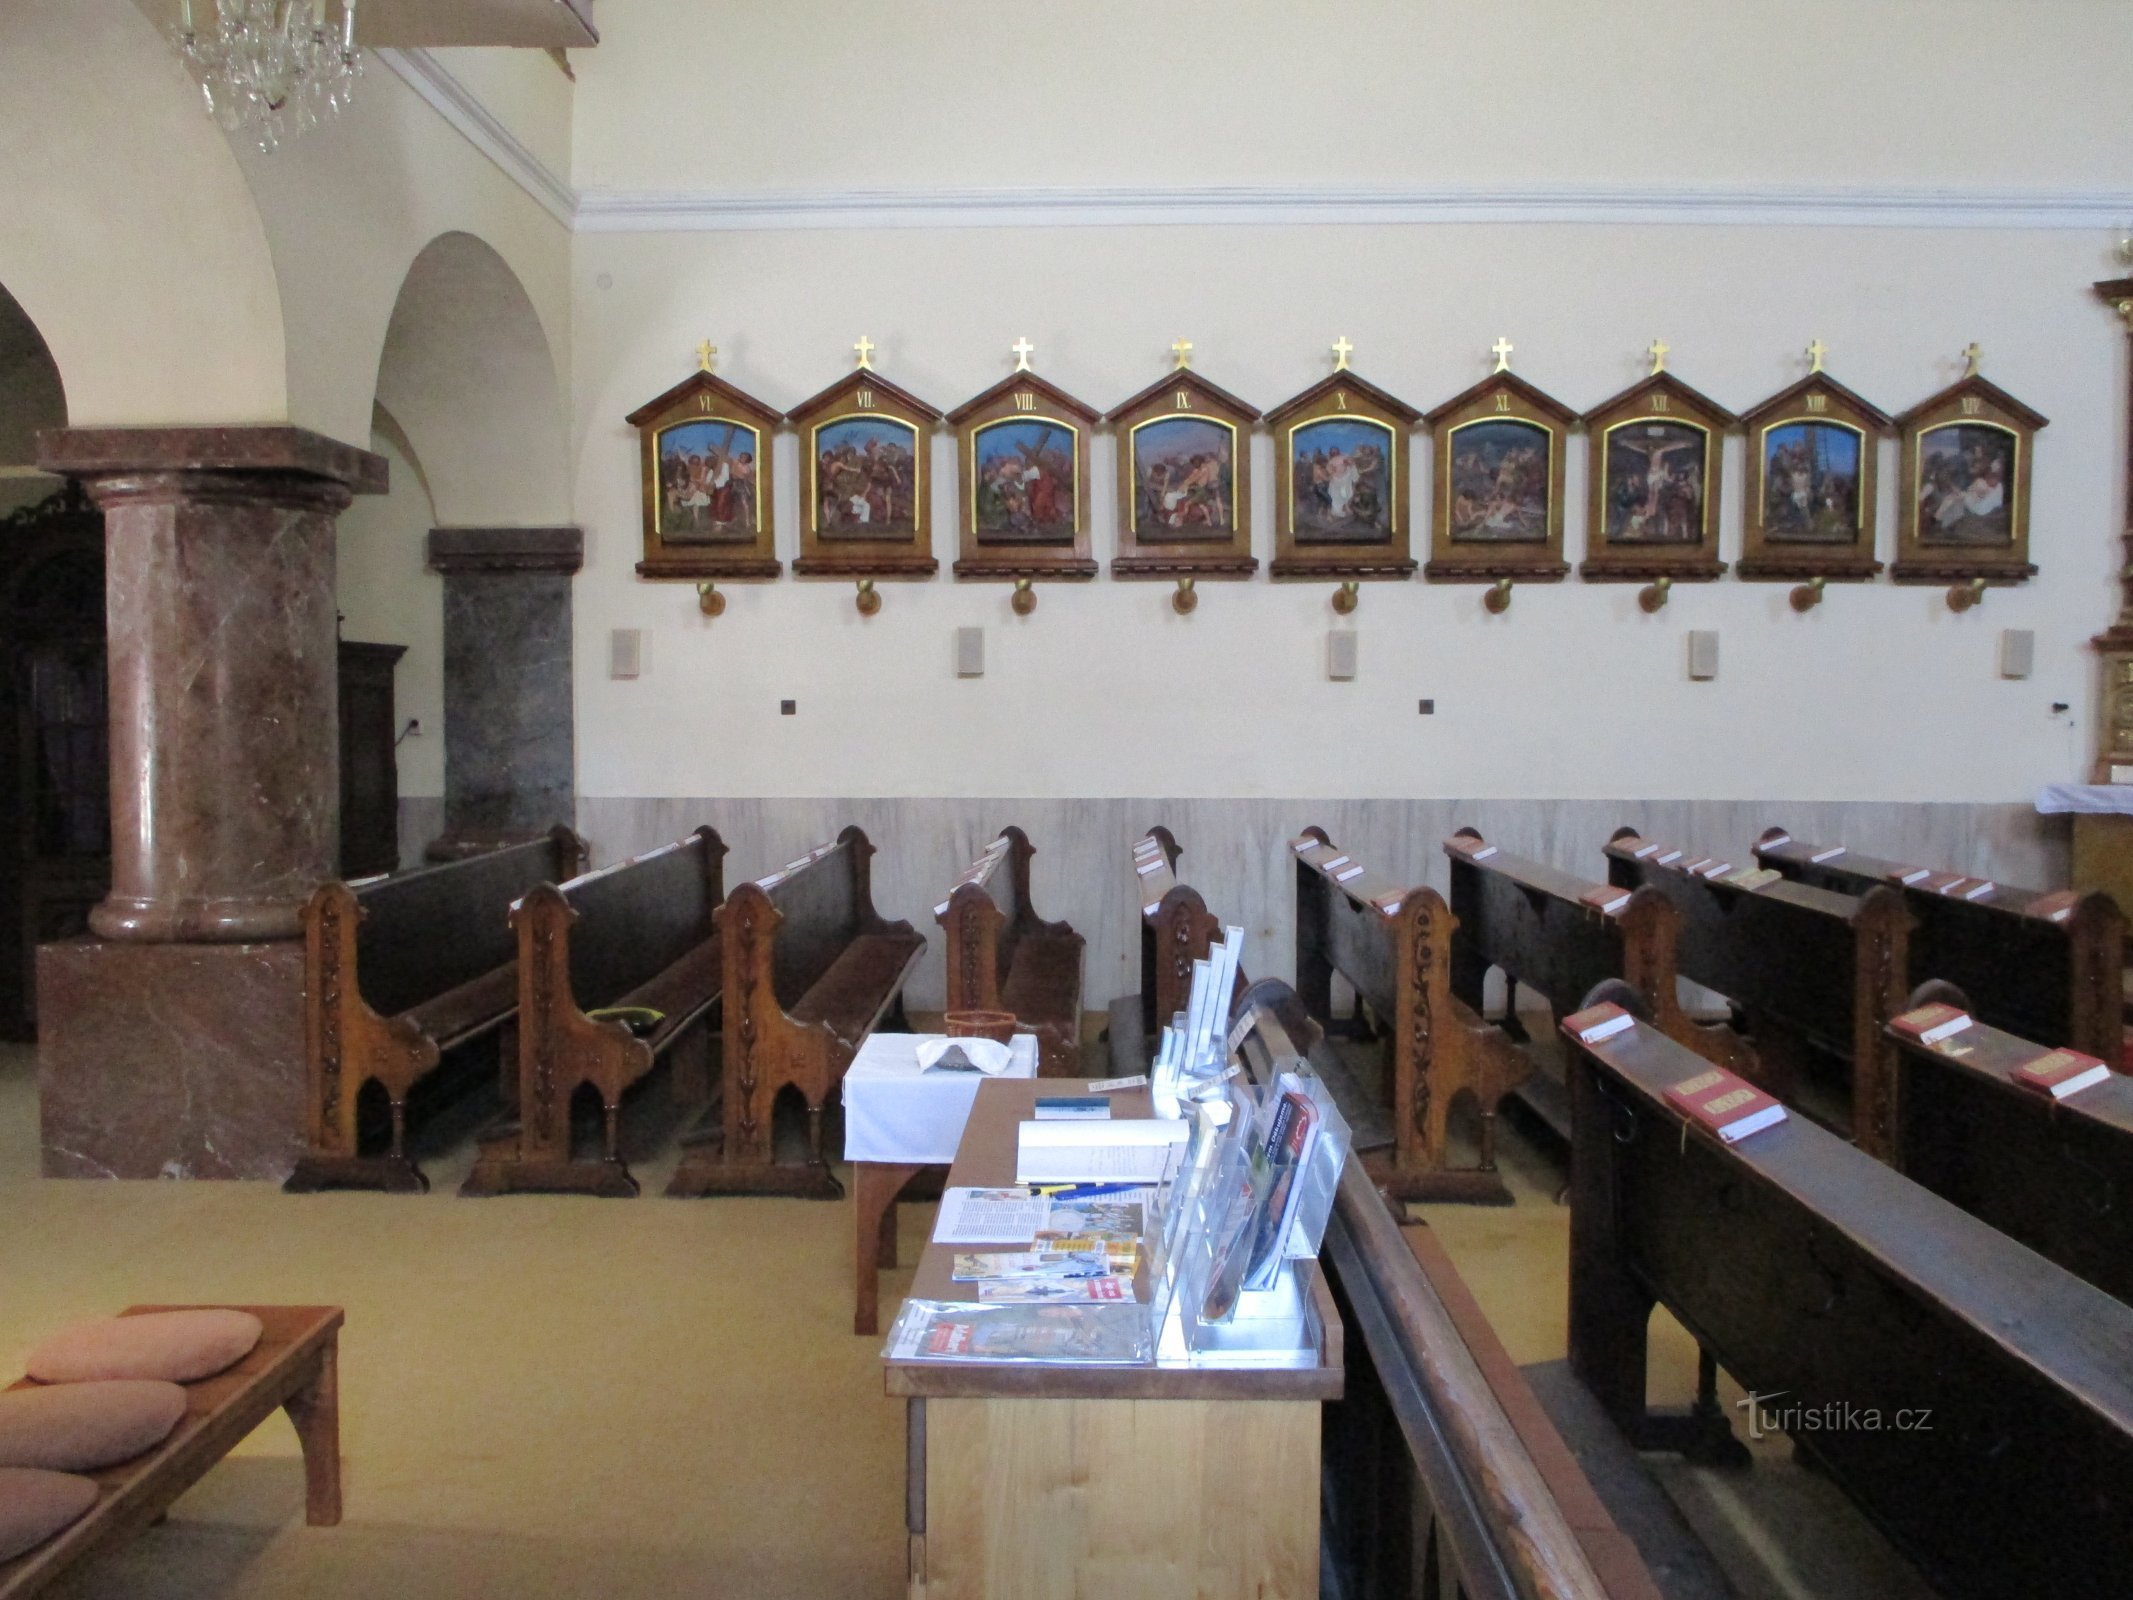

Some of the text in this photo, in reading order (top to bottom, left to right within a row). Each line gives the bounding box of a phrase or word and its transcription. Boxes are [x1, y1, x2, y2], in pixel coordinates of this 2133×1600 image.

[699, 395, 714, 411] VI.
[857, 391, 875, 407] VII.
[1014, 393, 1037, 410] VIII.
[1176, 392, 1191, 409] IX.
[1496, 395, 1510, 411] XI.
[1652, 394, 1669, 412] XII.
